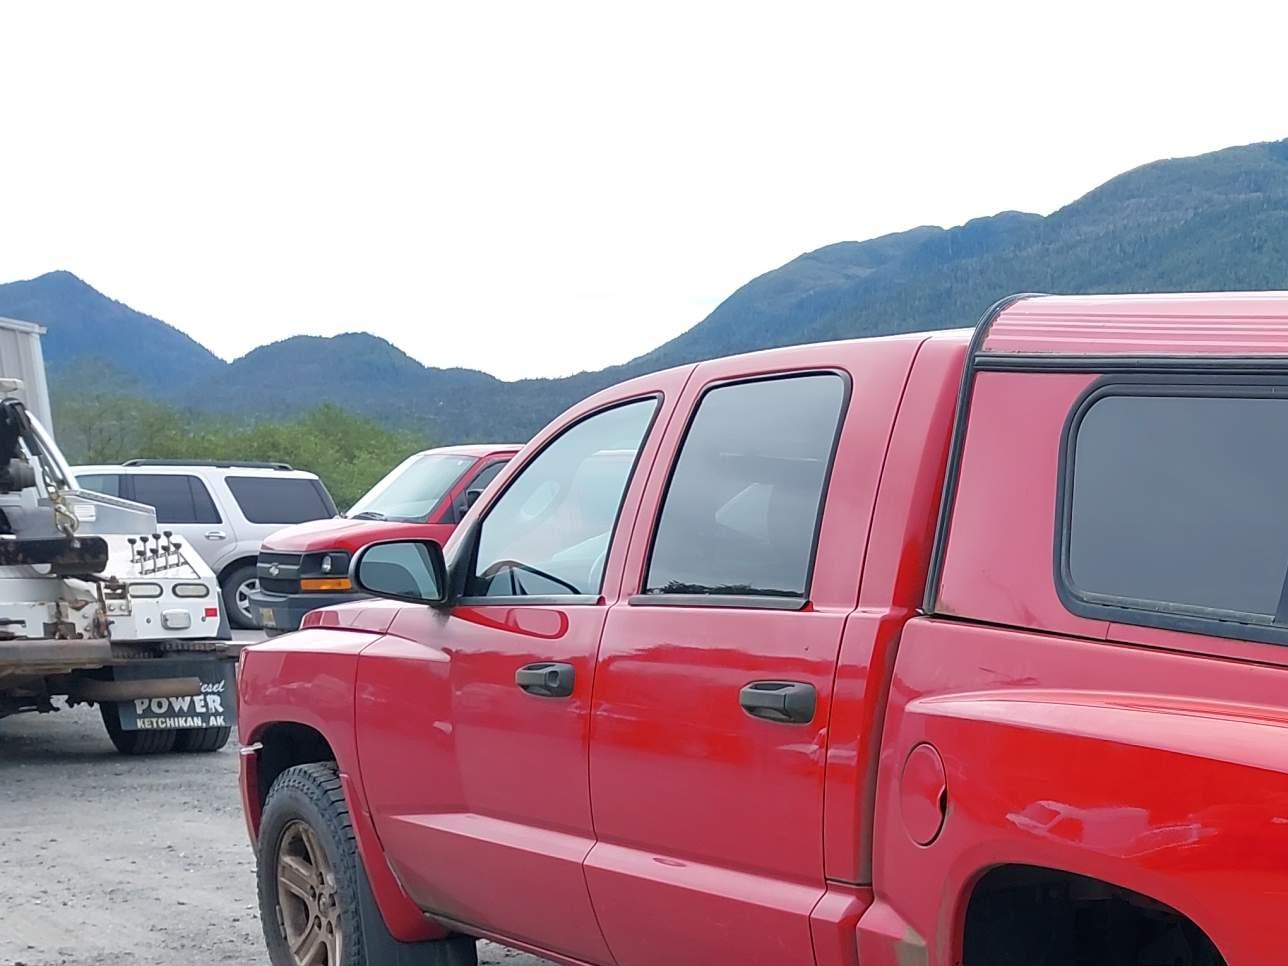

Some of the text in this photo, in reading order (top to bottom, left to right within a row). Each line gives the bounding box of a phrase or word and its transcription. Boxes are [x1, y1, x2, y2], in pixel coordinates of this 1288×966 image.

[200, 680, 224, 692] esel
[134, 694, 224, 715] POWER
[136, 716, 225, 728] KETCHIKAN, AK
